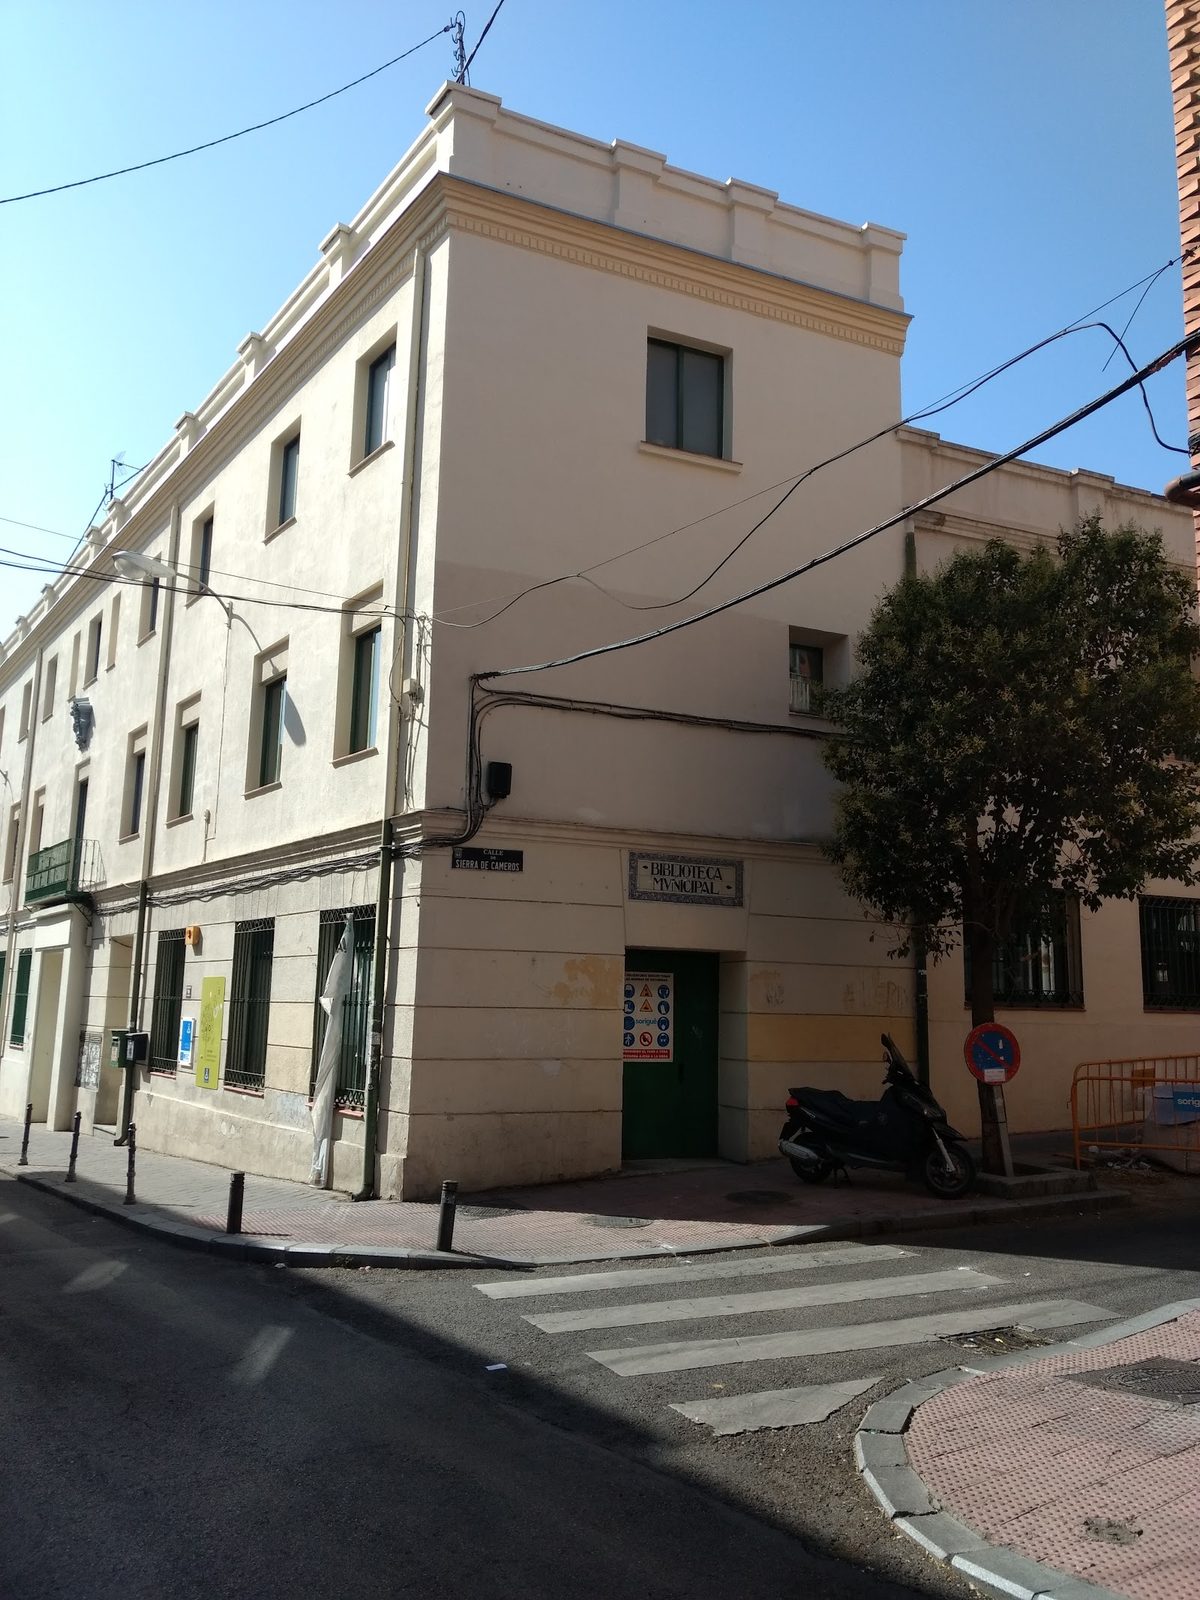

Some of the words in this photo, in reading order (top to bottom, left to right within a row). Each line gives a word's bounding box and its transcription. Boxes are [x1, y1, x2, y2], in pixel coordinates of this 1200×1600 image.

[483, 848, 504, 856] CALLE
[455, 859, 479, 869] SIERRA
[480, 860, 489, 870] DE
[491, 861, 520, 871] CAMEROS
[651, 862, 722, 880] BIBLIOTECA
